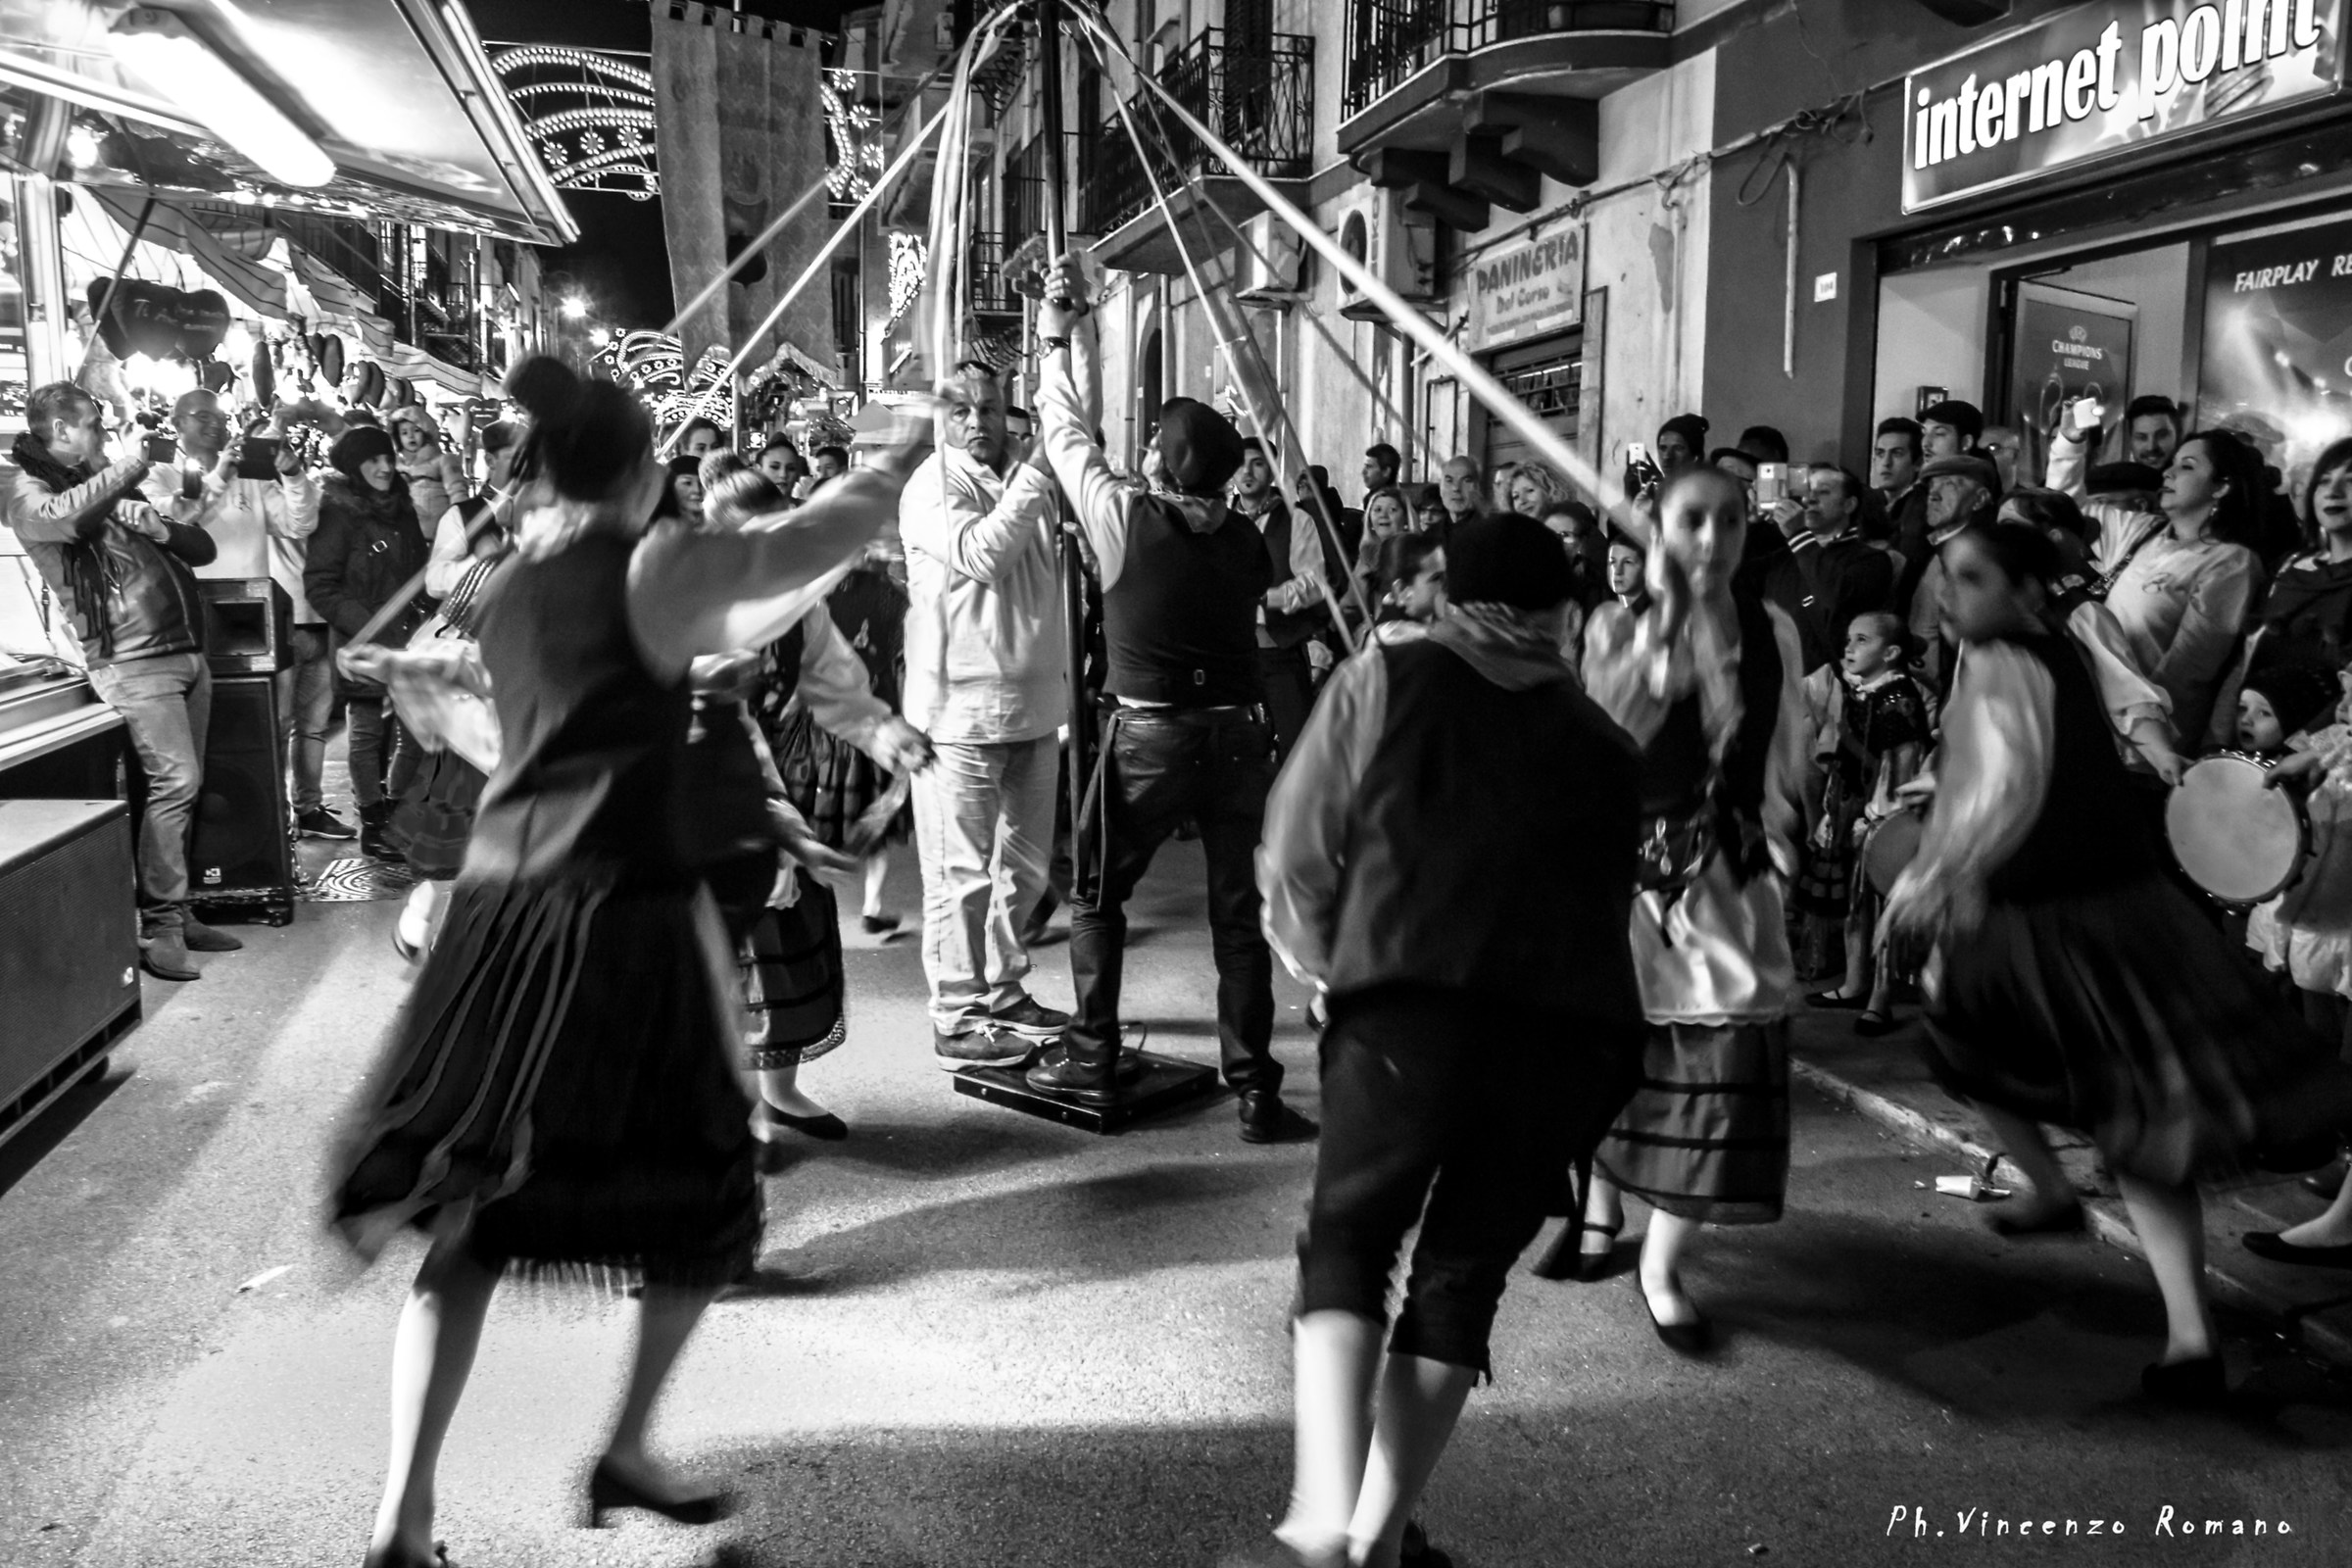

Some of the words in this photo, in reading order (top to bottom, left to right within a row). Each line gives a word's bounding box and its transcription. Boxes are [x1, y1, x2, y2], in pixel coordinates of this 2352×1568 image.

[1915, 20, 2123, 171] internet
[1476, 231, 1579, 295] PANINERIA
[2234, 259, 2320, 293] FAIRPLAY
[2052, 339, 2102, 360] CHAMPIONS
